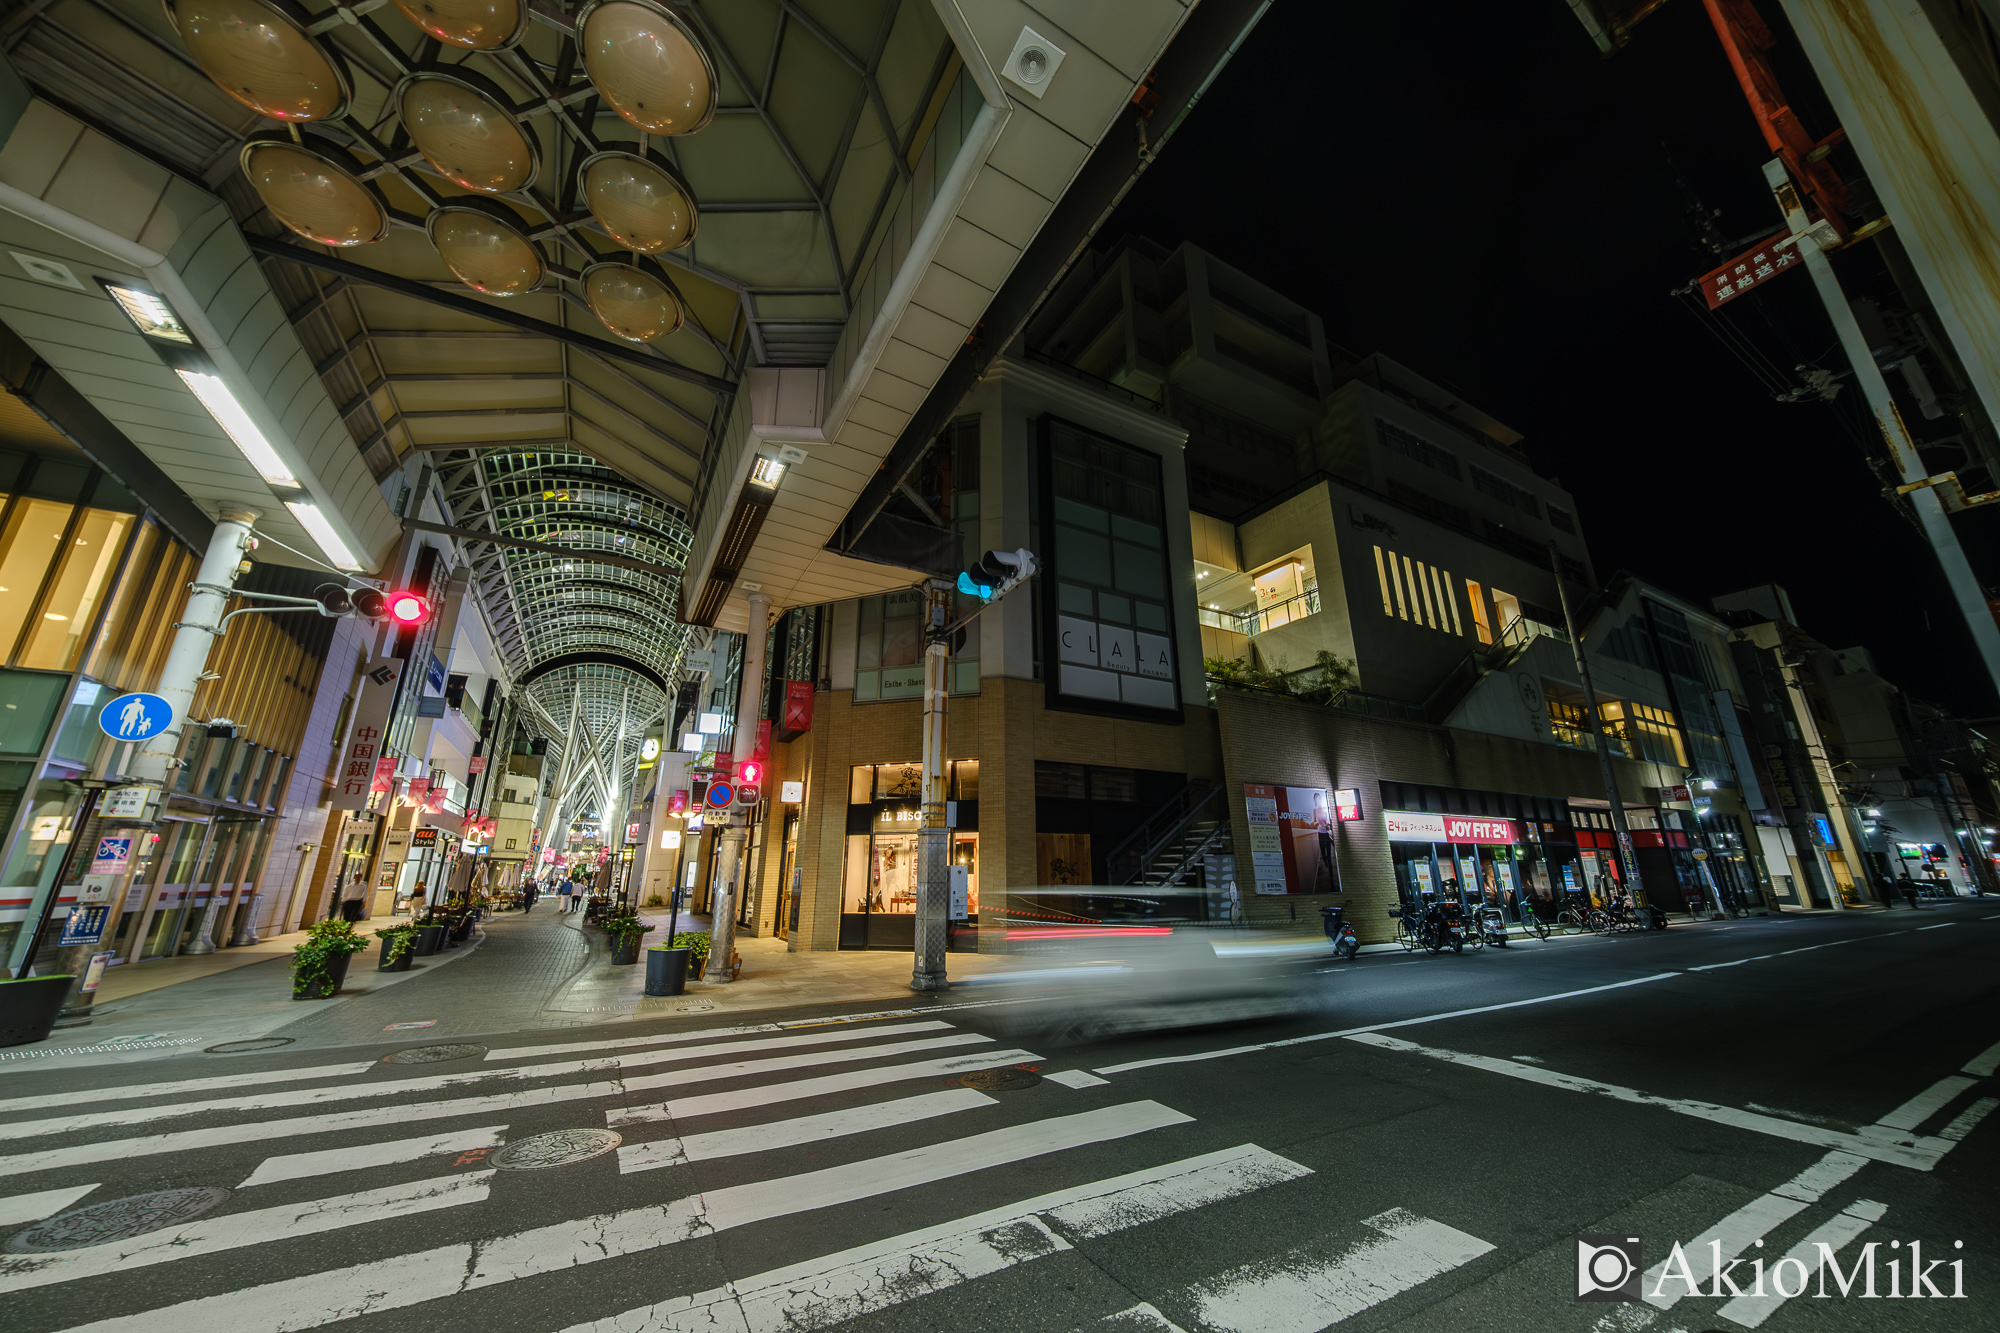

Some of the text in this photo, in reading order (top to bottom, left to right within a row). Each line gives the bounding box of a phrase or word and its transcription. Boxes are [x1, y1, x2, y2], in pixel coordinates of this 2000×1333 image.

[1062, 631, 1169, 667] CLALA
[1107, 661, 1131, 671] Beauty
[884, 680, 903, 689] Esthe
[343, 726, 379, 796] 中国銀行
[881, 812, 892, 821] IL
[1388, 820, 1400, 832] 24
